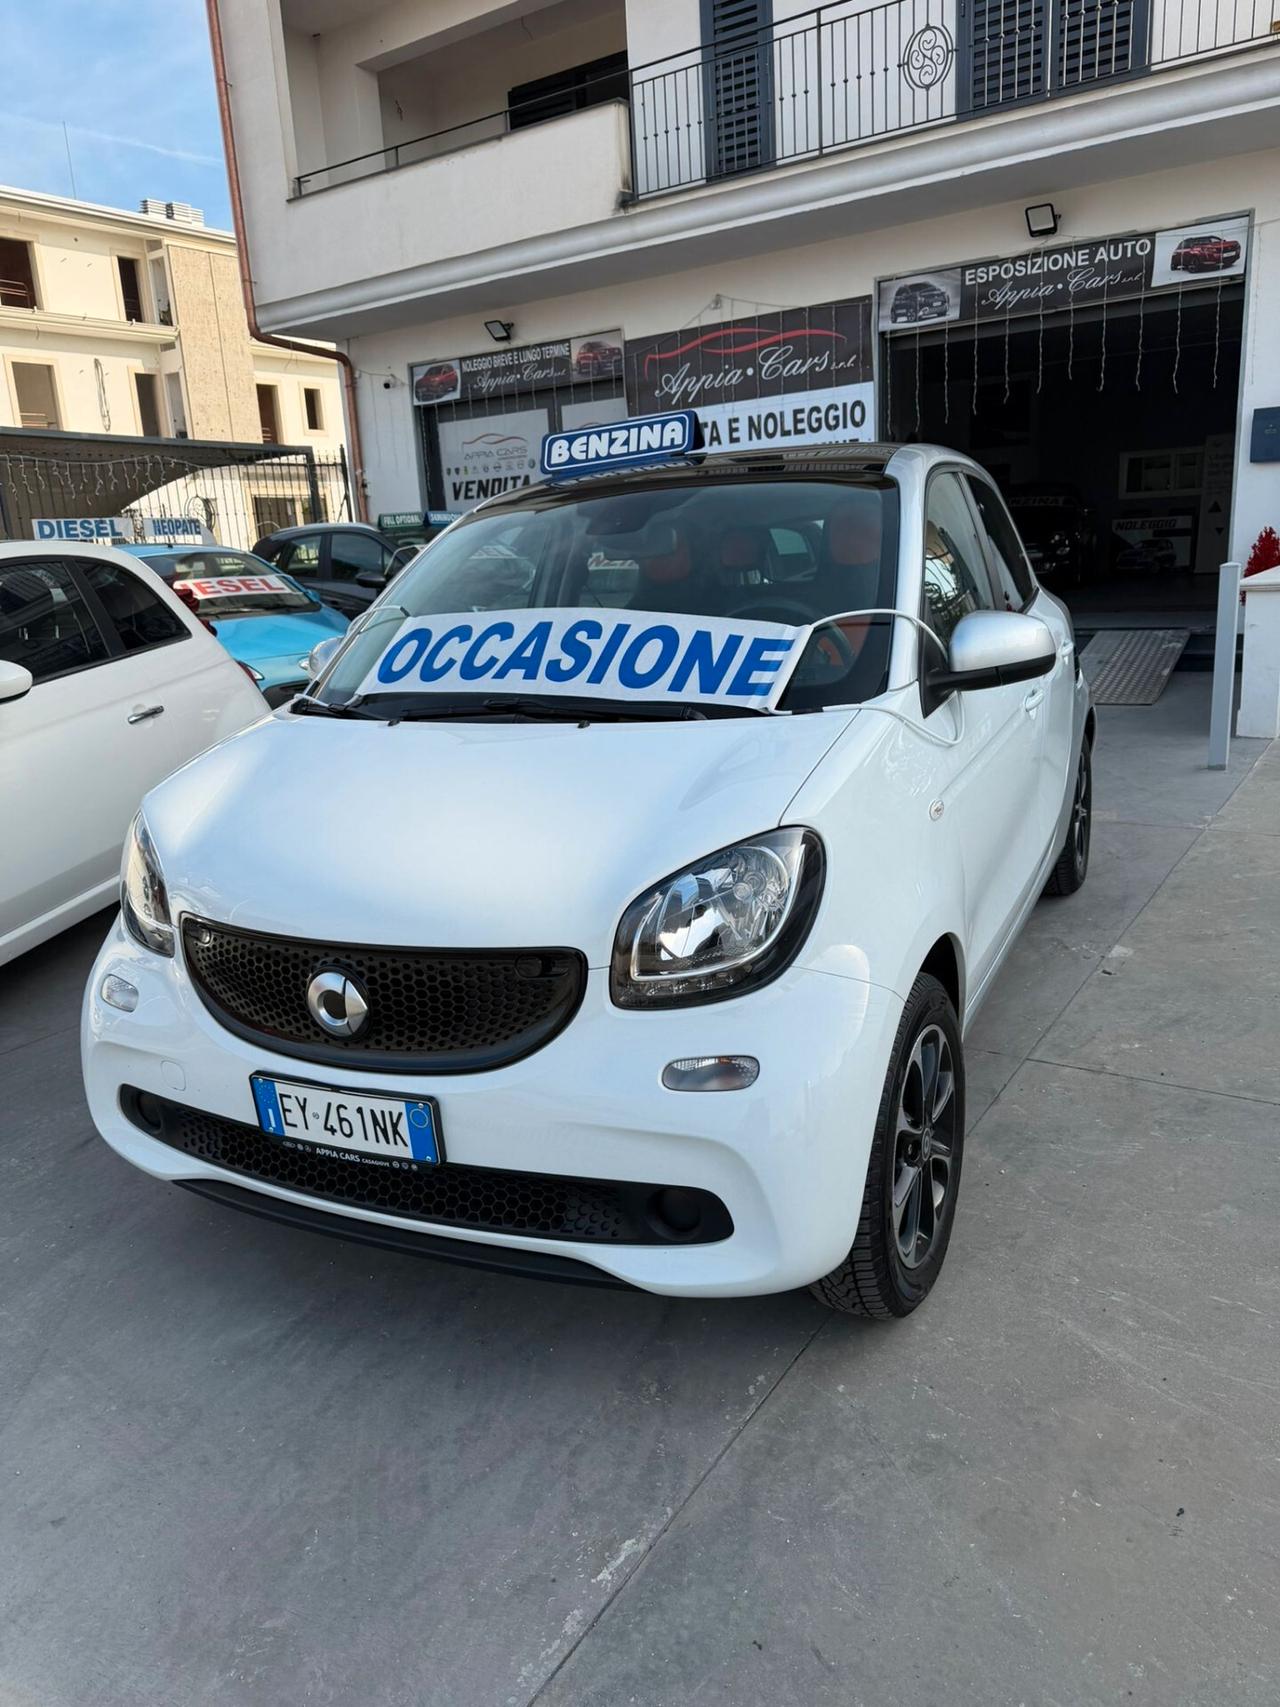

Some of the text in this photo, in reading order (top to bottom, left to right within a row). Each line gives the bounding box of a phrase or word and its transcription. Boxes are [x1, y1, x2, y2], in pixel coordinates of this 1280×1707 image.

[965, 238, 1151, 285] ESPOSIZIONE AUTO
[981, 281, 1055, 310] Appia
[1067, 267, 1123, 291] Cars
[461, 343, 570, 372] NOLEGGIO BREVE E LUNGO TERMINE
[654, 362, 744, 405] Appia
[758, 345, 829, 381] Cars
[474, 370, 517, 392] Appia
[521, 363, 555, 381] Cars
[728, 417, 741, 443] E
[748, 399, 866, 442] NOLEGGIO
[464, 450, 495, 460] APPIA
[496, 446, 528, 457] CARS
[550, 421, 684, 465] BENZINA
[36, 519, 124, 540] DIESEL
[1115, 519, 1176, 530] NOLEGGIO
[377, 619, 796, 698] OCCASIONE
[315, 1147, 339, 1160] APPIA
[339, 1152, 361, 1163] CARS
